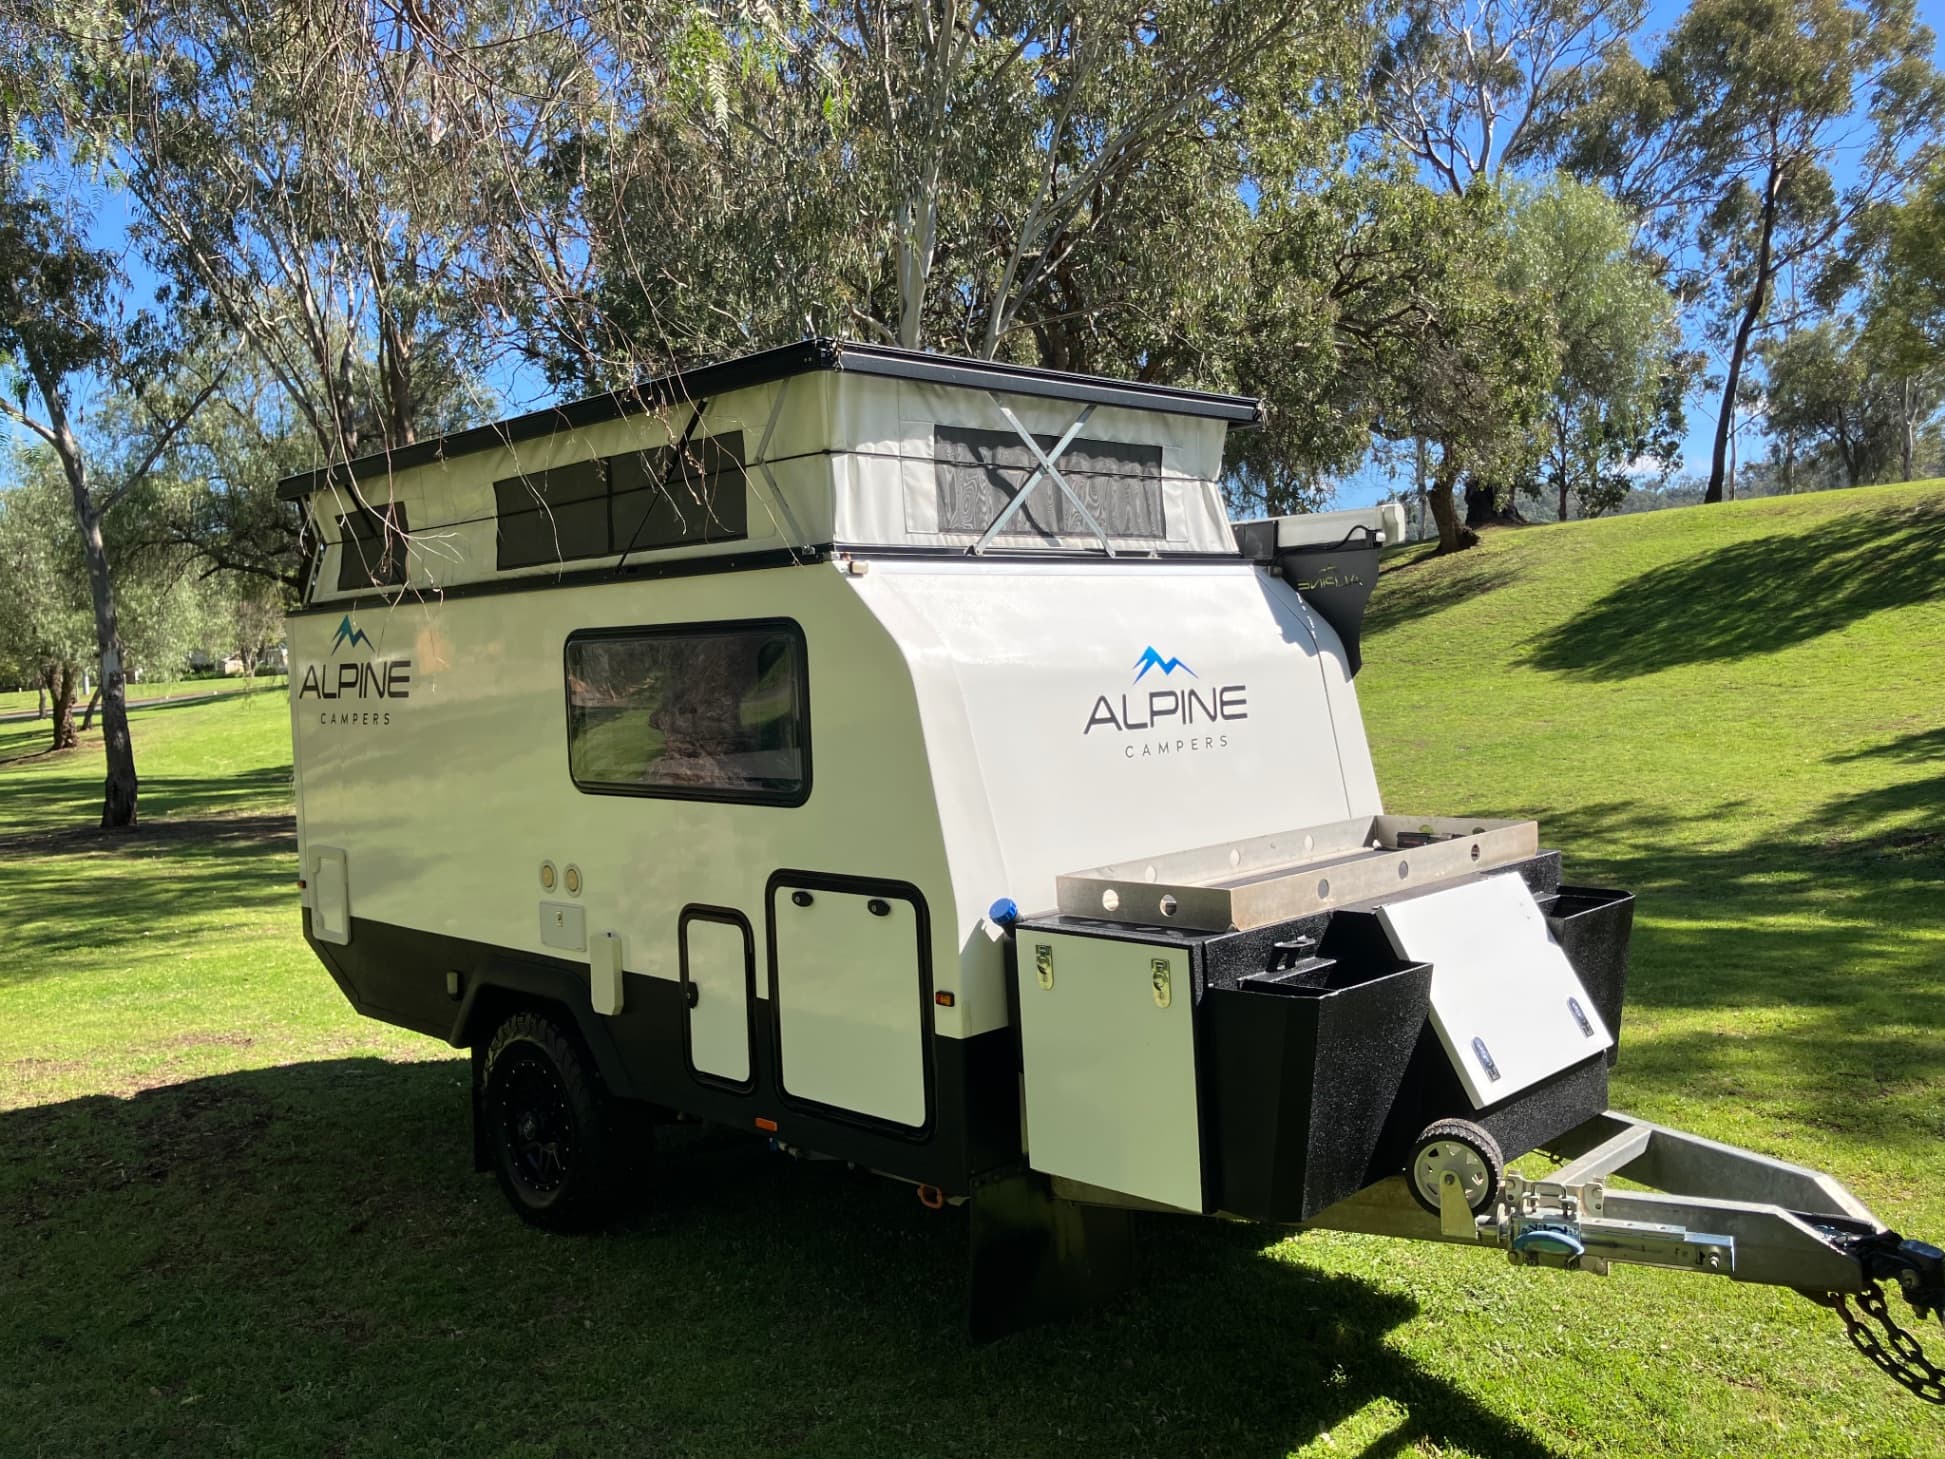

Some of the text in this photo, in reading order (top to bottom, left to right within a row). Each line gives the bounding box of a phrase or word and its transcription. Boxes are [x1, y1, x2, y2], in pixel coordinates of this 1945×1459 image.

[299, 660, 411, 700] ALPINE
[320, 712, 390, 726] CAMPERS
[1084, 685, 1248, 735] ALPINE
[1125, 735, 1228, 759] CAMPERS
